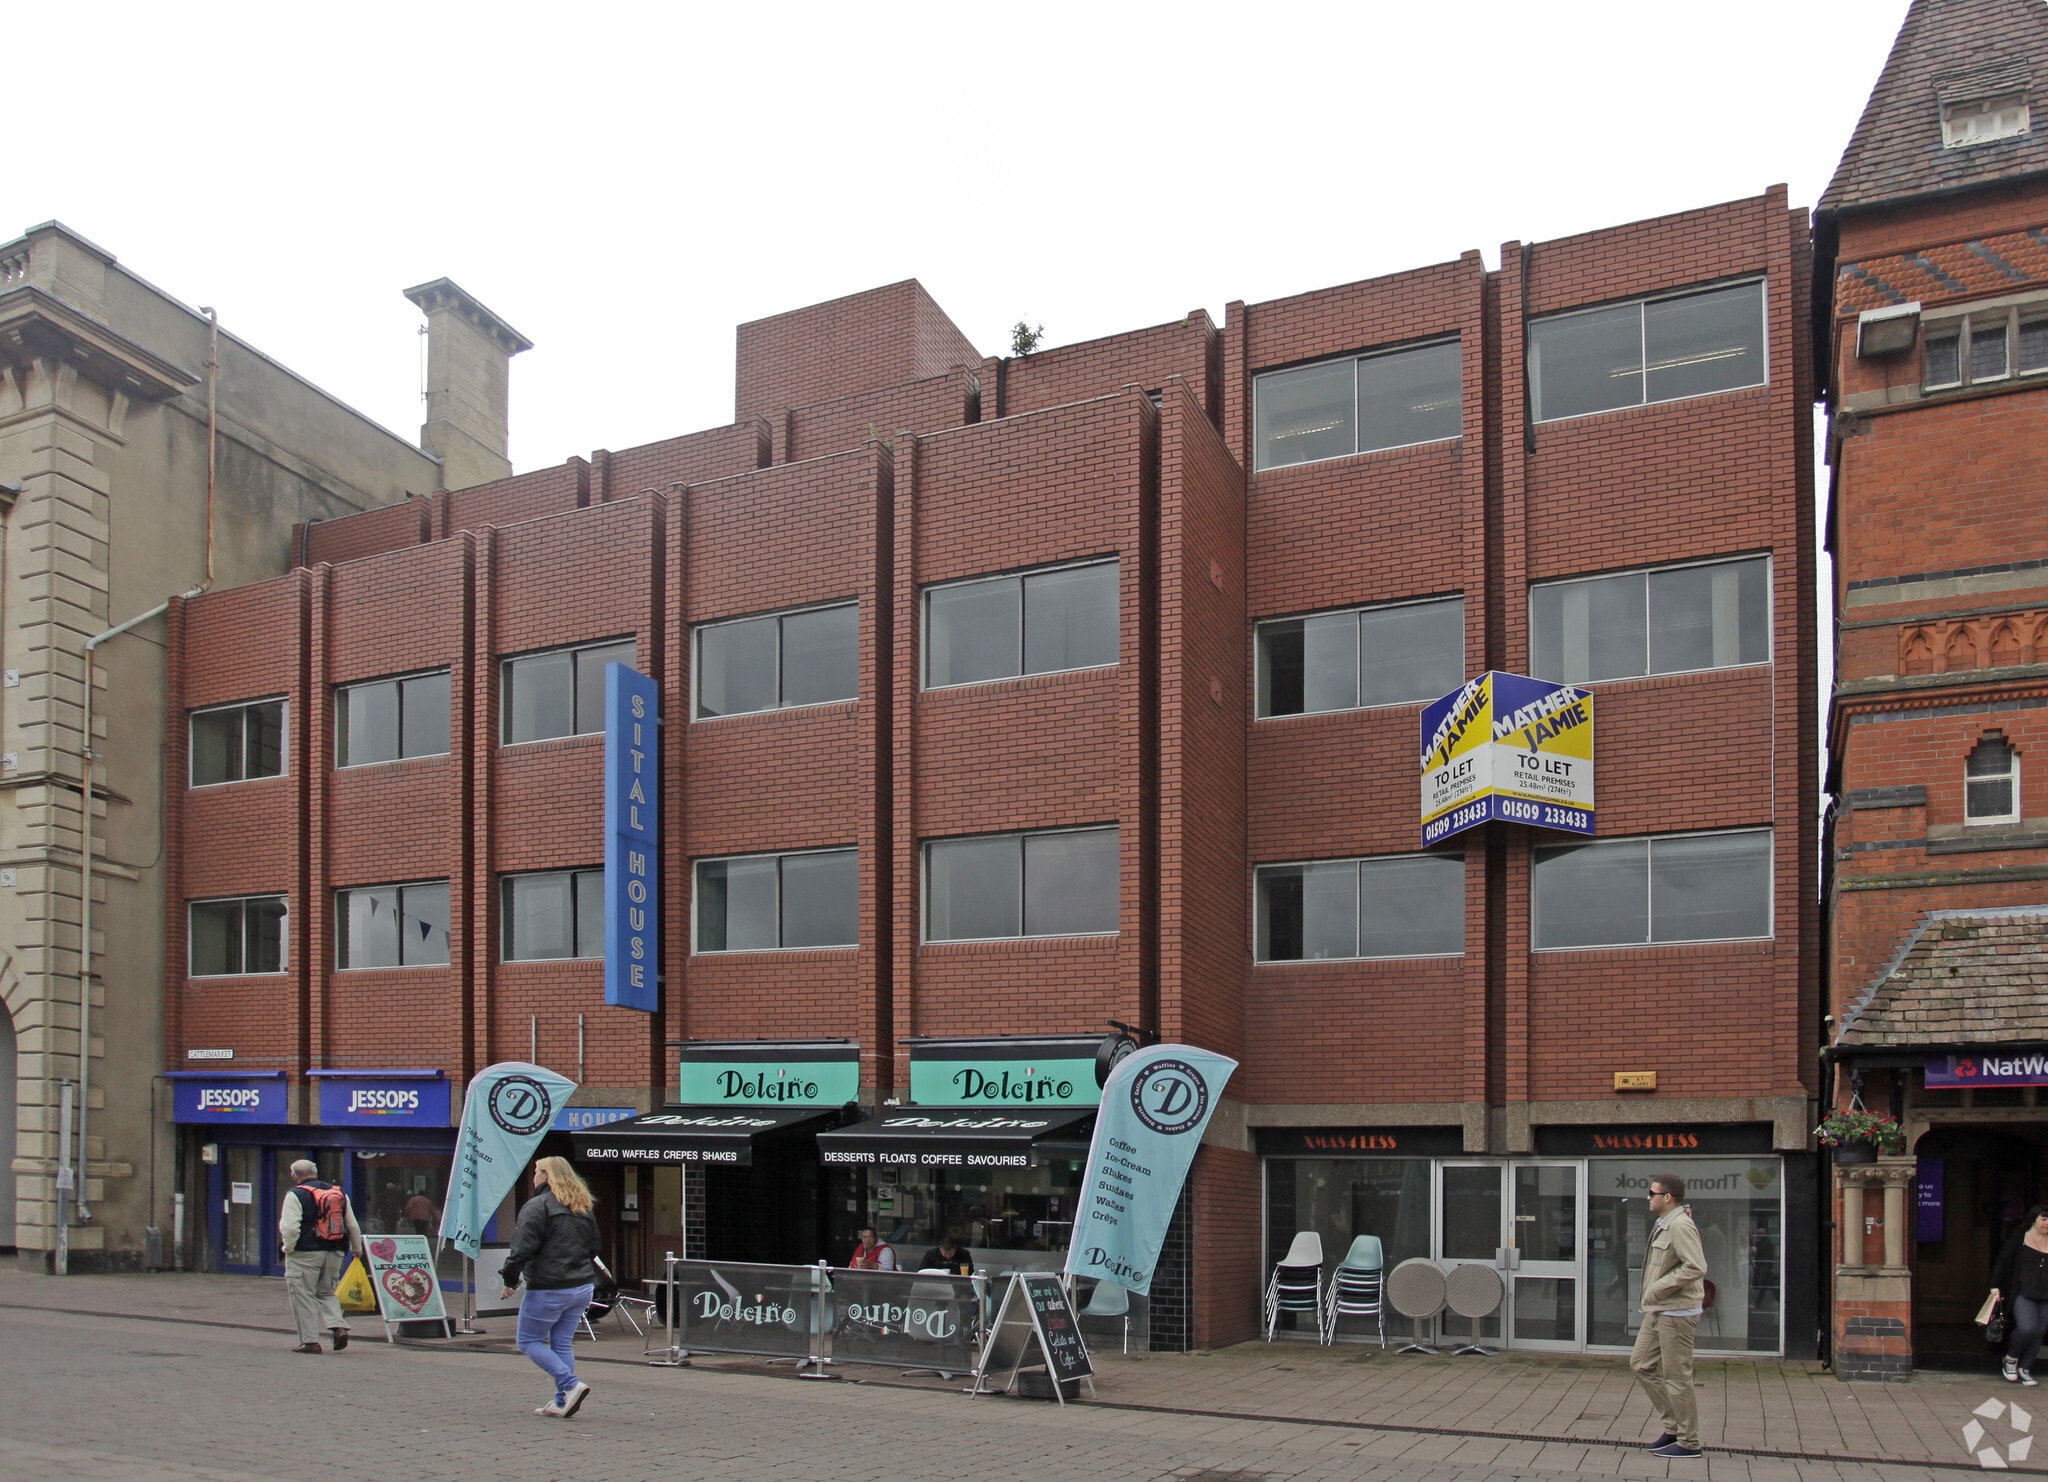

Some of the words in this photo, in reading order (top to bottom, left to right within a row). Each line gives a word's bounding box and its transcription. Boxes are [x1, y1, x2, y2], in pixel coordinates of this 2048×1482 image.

[1421, 679, 1480, 770] MATHER
[1493, 687, 1580, 740] MATHER
[1439, 688, 1488, 766] JAMIE
[1523, 703, 1588, 754] JAMIE
[629, 694, 646, 831] SITAL
[1435, 771, 1449, 787] TO
[1453, 758, 1473, 779] LET
[1517, 754, 1540, 770] TO
[1545, 759, 1572, 776] LET
[1433, 787, 1449, 800] RETAIL
[1451, 774, 1476, 792] PREMISES
[1514, 771, 1540, 783] RETAIL
[1541, 776, 1576, 789] PREMISES
[1426, 817, 1450, 840] 01509
[1453, 801, 1487, 829] 233433
[1502, 800, 1540, 820] 01509
[1544, 807, 1587, 829] 233433
[627, 850, 646, 988] HOUSE
[190, 1050, 231, 1058] CATTLEMARKET
[197, 1089, 260, 1110] JESSOPS
[348, 1090, 419, 1112] JESSOPS
[1360, 1135, 1398, 1149] LESS
[1593, 1134, 1642, 1149] XMAS
[1656, 1133, 1699, 1149] LESS
[587, 1149, 618, 1159] GELATO
[622, 1149, 660, 1160] WAFFLES
[663, 1150, 698, 1160] CREPES
[702, 1151, 737, 1161] SHAKES
[824, 1152, 875, 1163] DESSERTS
[879, 1153, 917, 1164] FLOATS
[921, 1154, 962, 1165] COFFEE
[967, 1155, 1027, 1166] SAVOURIES
